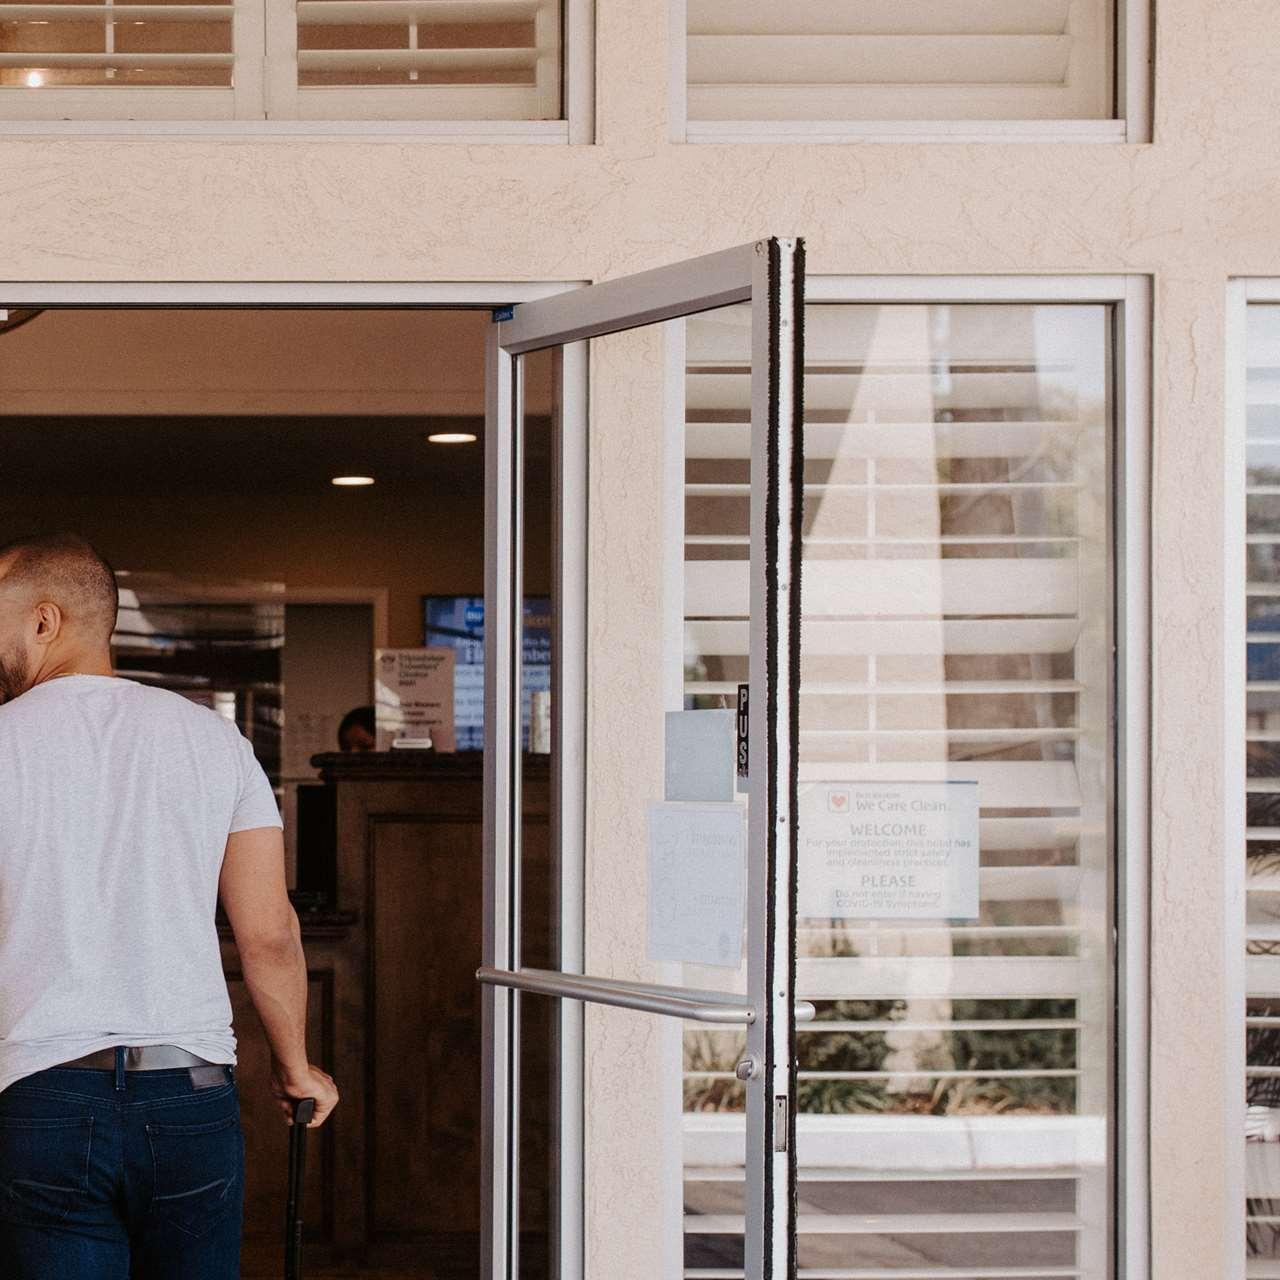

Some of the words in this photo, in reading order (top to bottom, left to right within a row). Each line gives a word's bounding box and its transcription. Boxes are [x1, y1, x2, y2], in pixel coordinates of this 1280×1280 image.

[856, 801, 875, 812] We
[878, 801, 907, 812] Care
[850, 823, 928, 837] WELCOME
[861, 874, 916, 887] PLEASE
